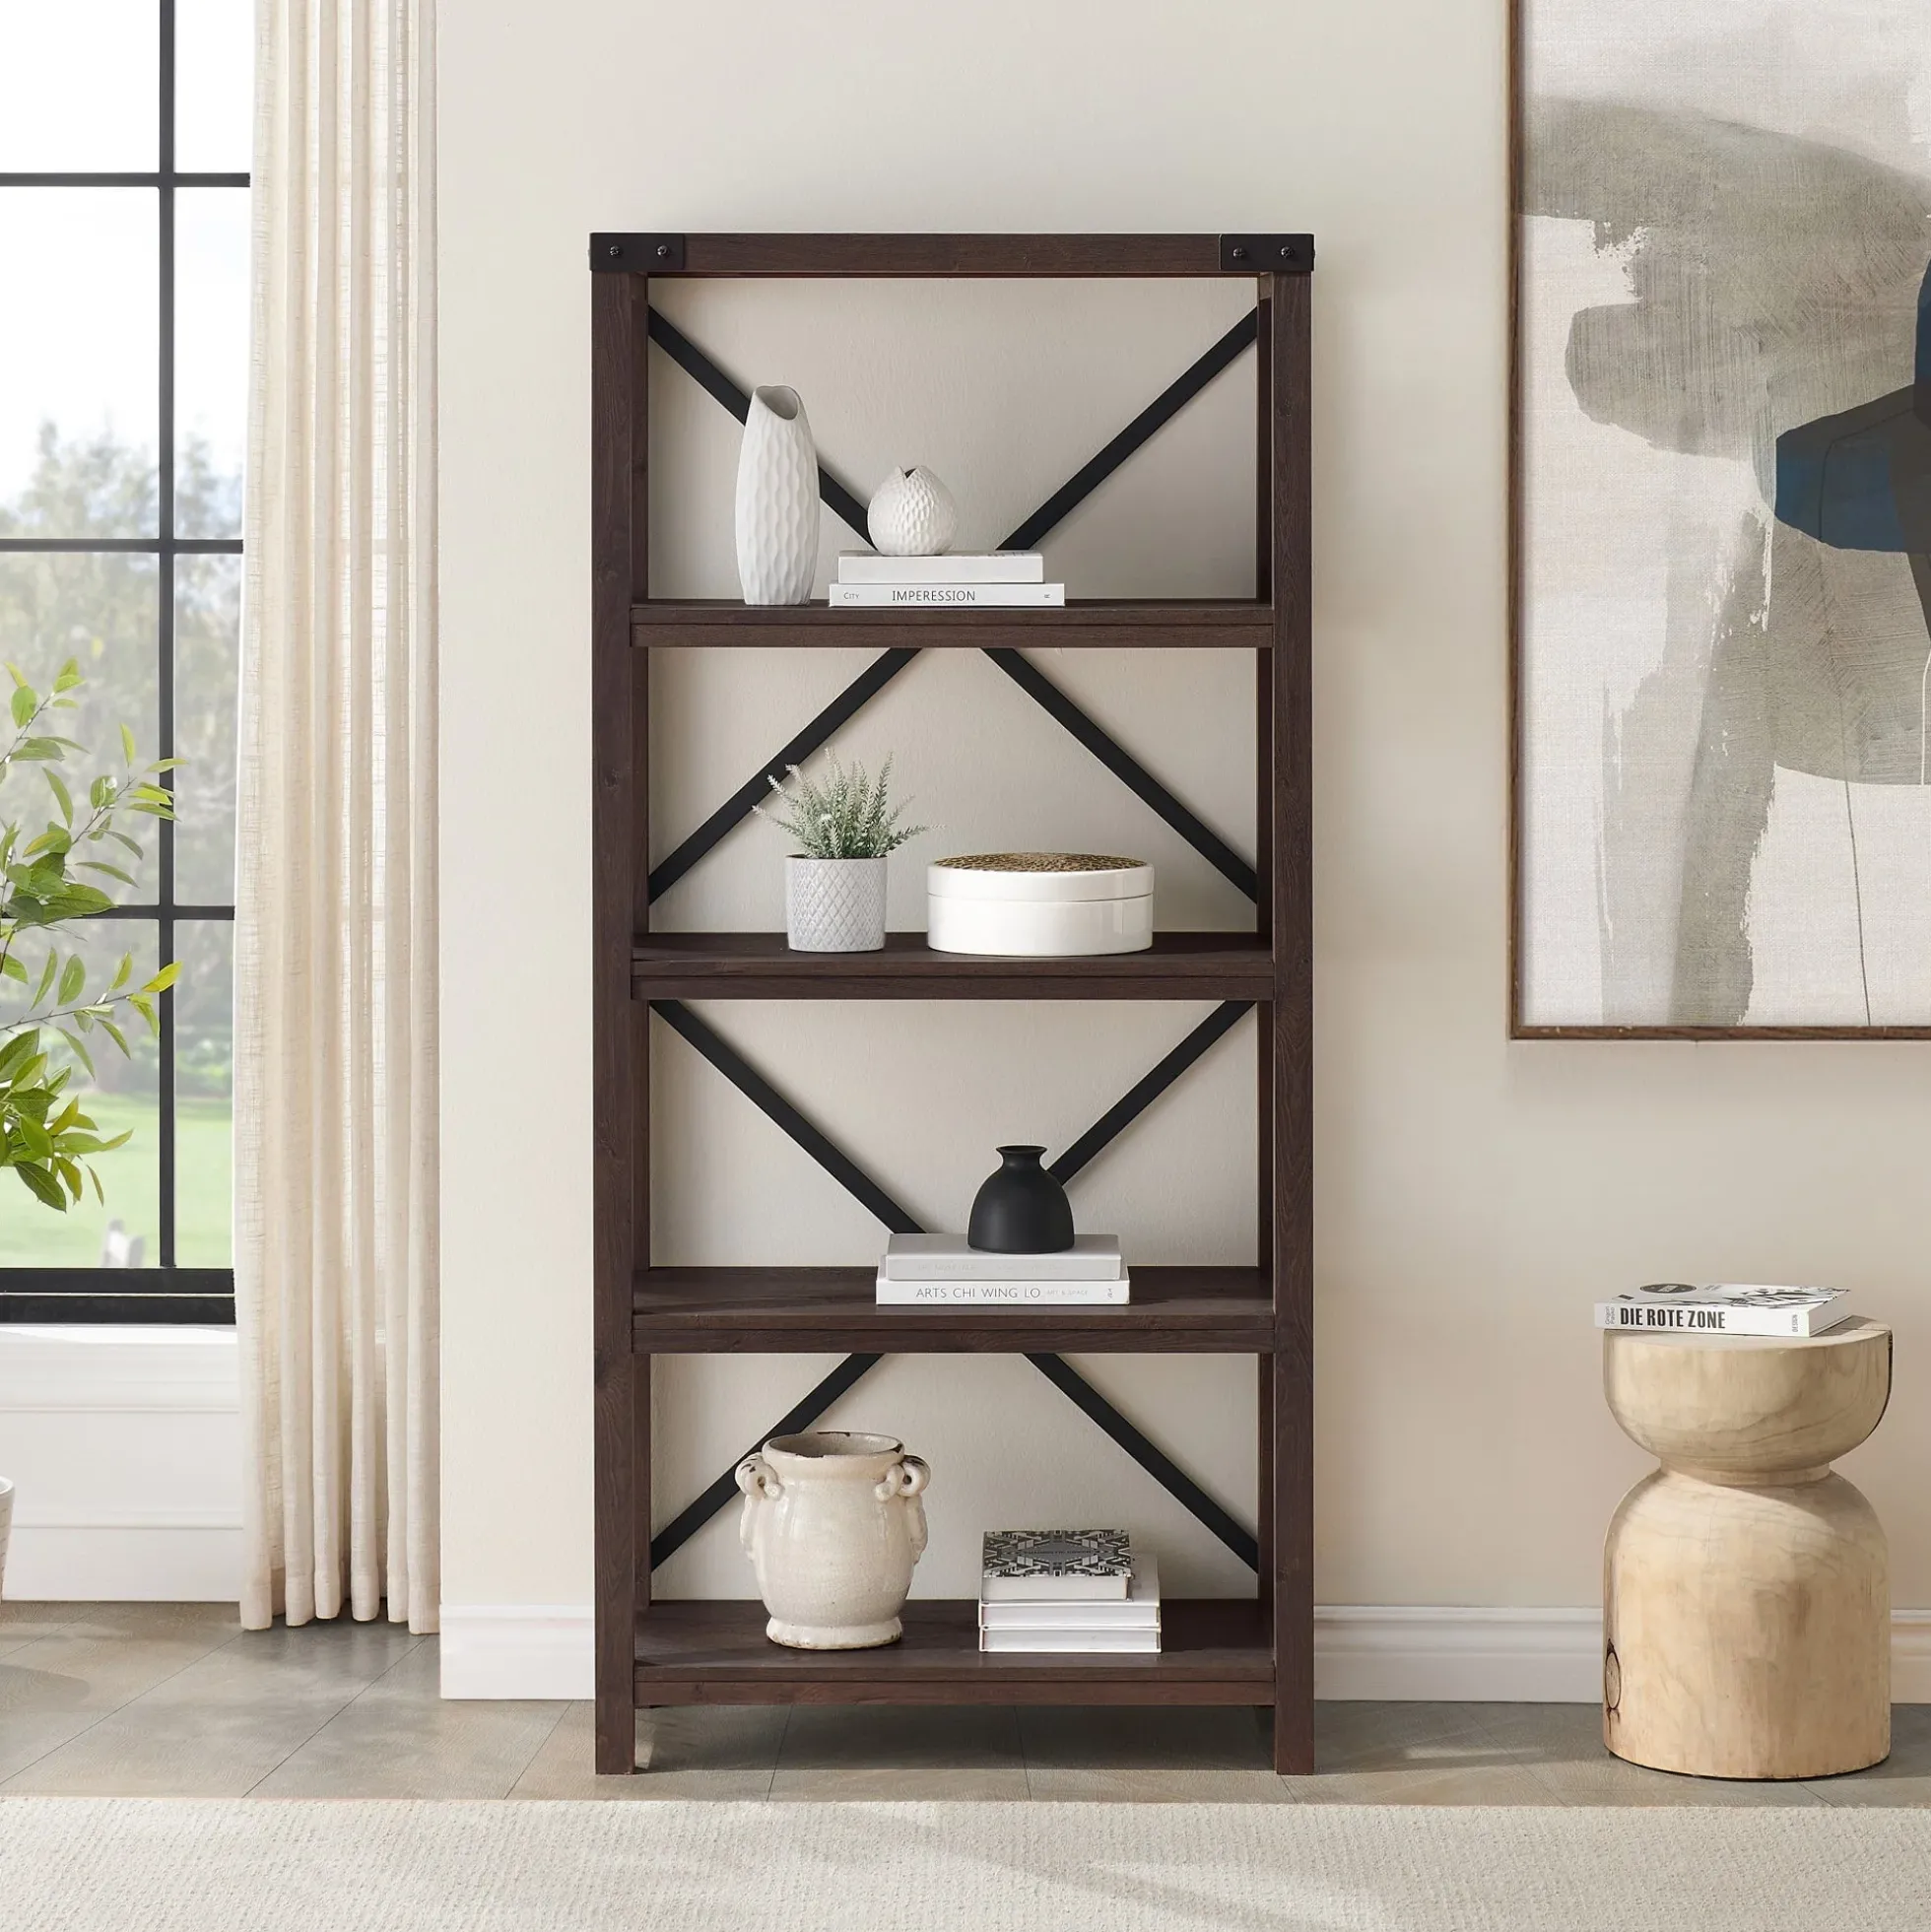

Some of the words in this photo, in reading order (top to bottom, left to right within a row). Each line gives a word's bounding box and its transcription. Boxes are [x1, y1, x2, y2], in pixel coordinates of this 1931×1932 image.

[892, 590, 975, 602] IMPERESSION
[915, 1288, 947, 1299] ARTS
[952, 1288, 975, 1299] CHI
[981, 1288, 1019, 1299] WING
[1025, 1288, 1041, 1299] LO
[1620, 1307, 1643, 1326] DIE
[1646, 1308, 1684, 1327] ROTE
[1687, 1309, 1726, 1329] ZONE
